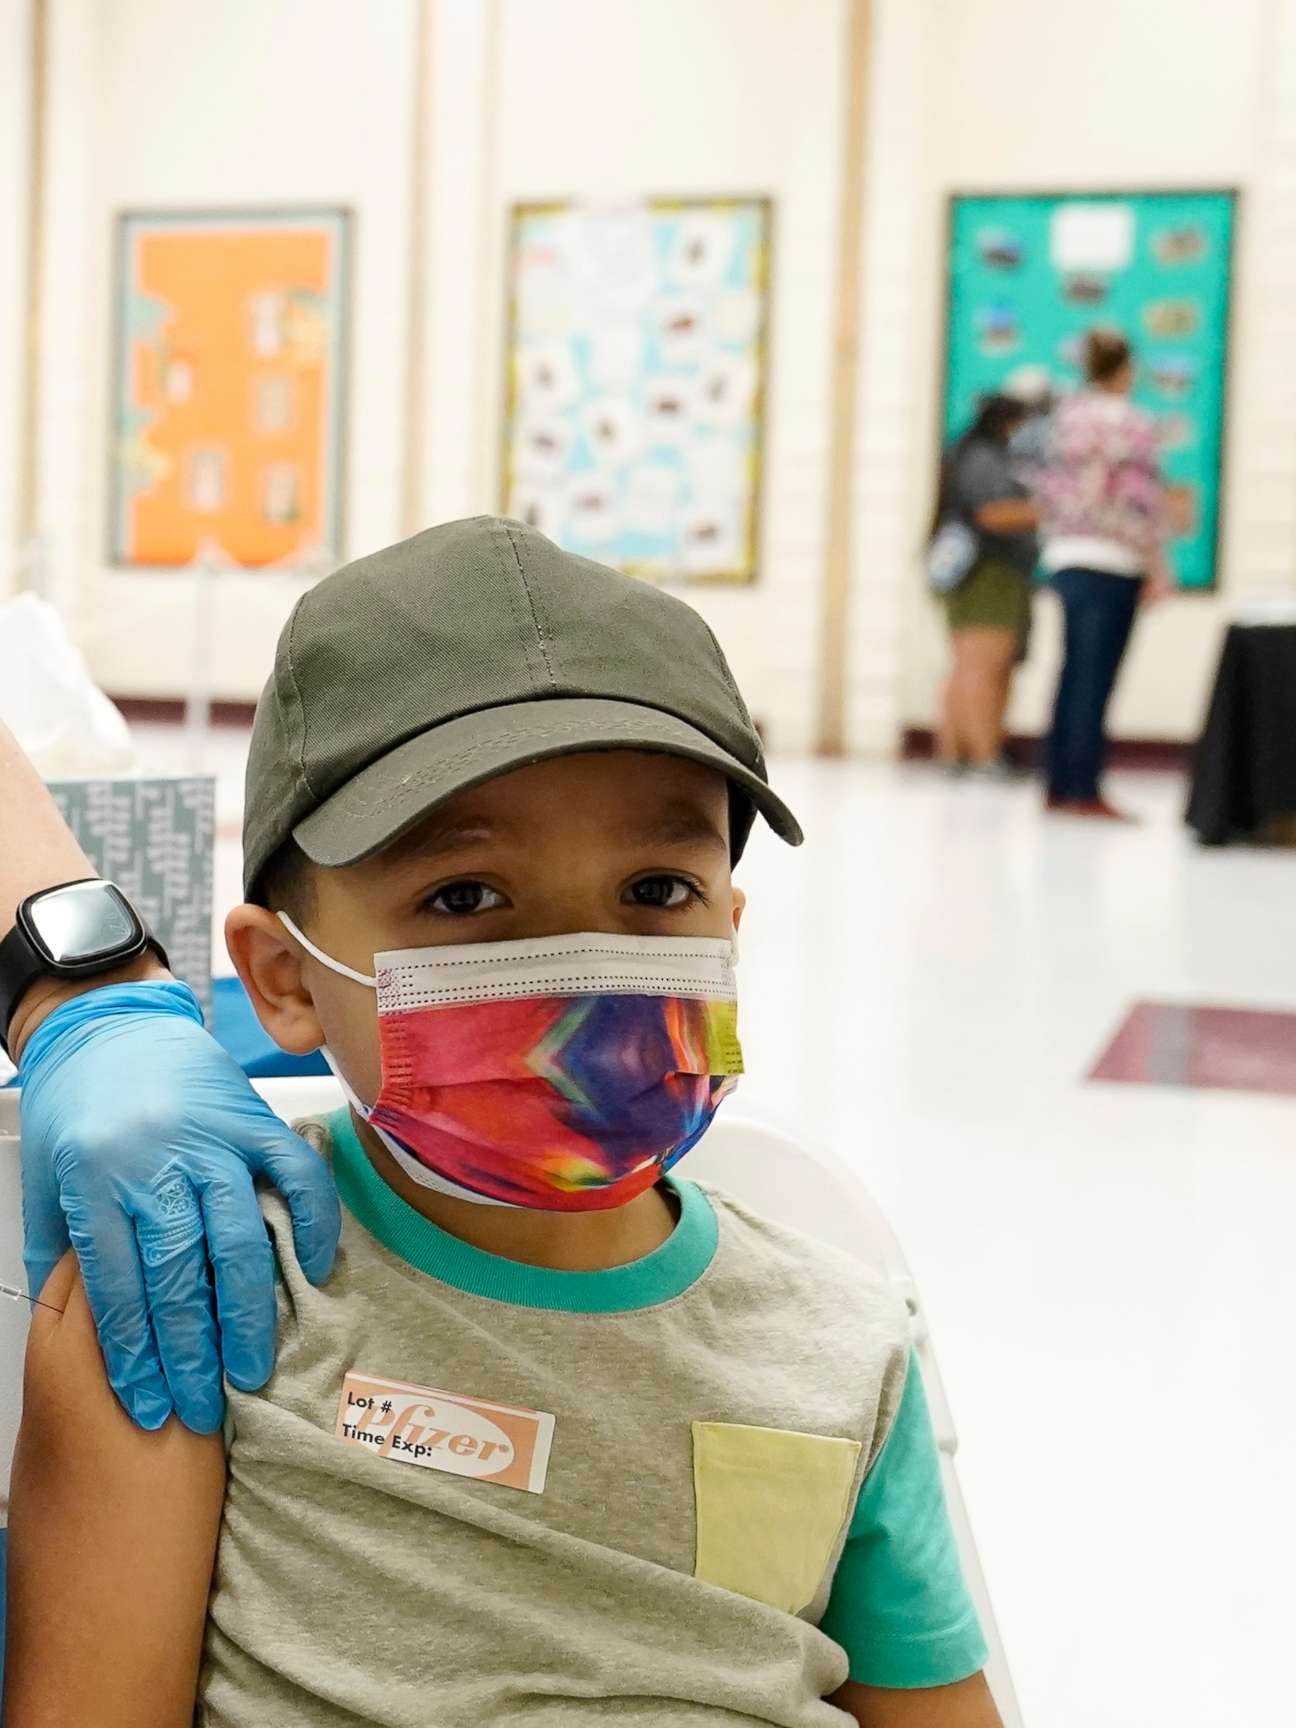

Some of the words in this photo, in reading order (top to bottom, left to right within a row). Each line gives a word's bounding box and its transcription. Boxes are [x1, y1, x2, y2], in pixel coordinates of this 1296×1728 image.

[347, 1391, 375, 1410] Lot
[380, 1400, 393, 1415] #
[342, 1423, 385, 1446] Time
[391, 1435, 433, 1459] Exp:
[348, 1403, 510, 1463] Pfizer
